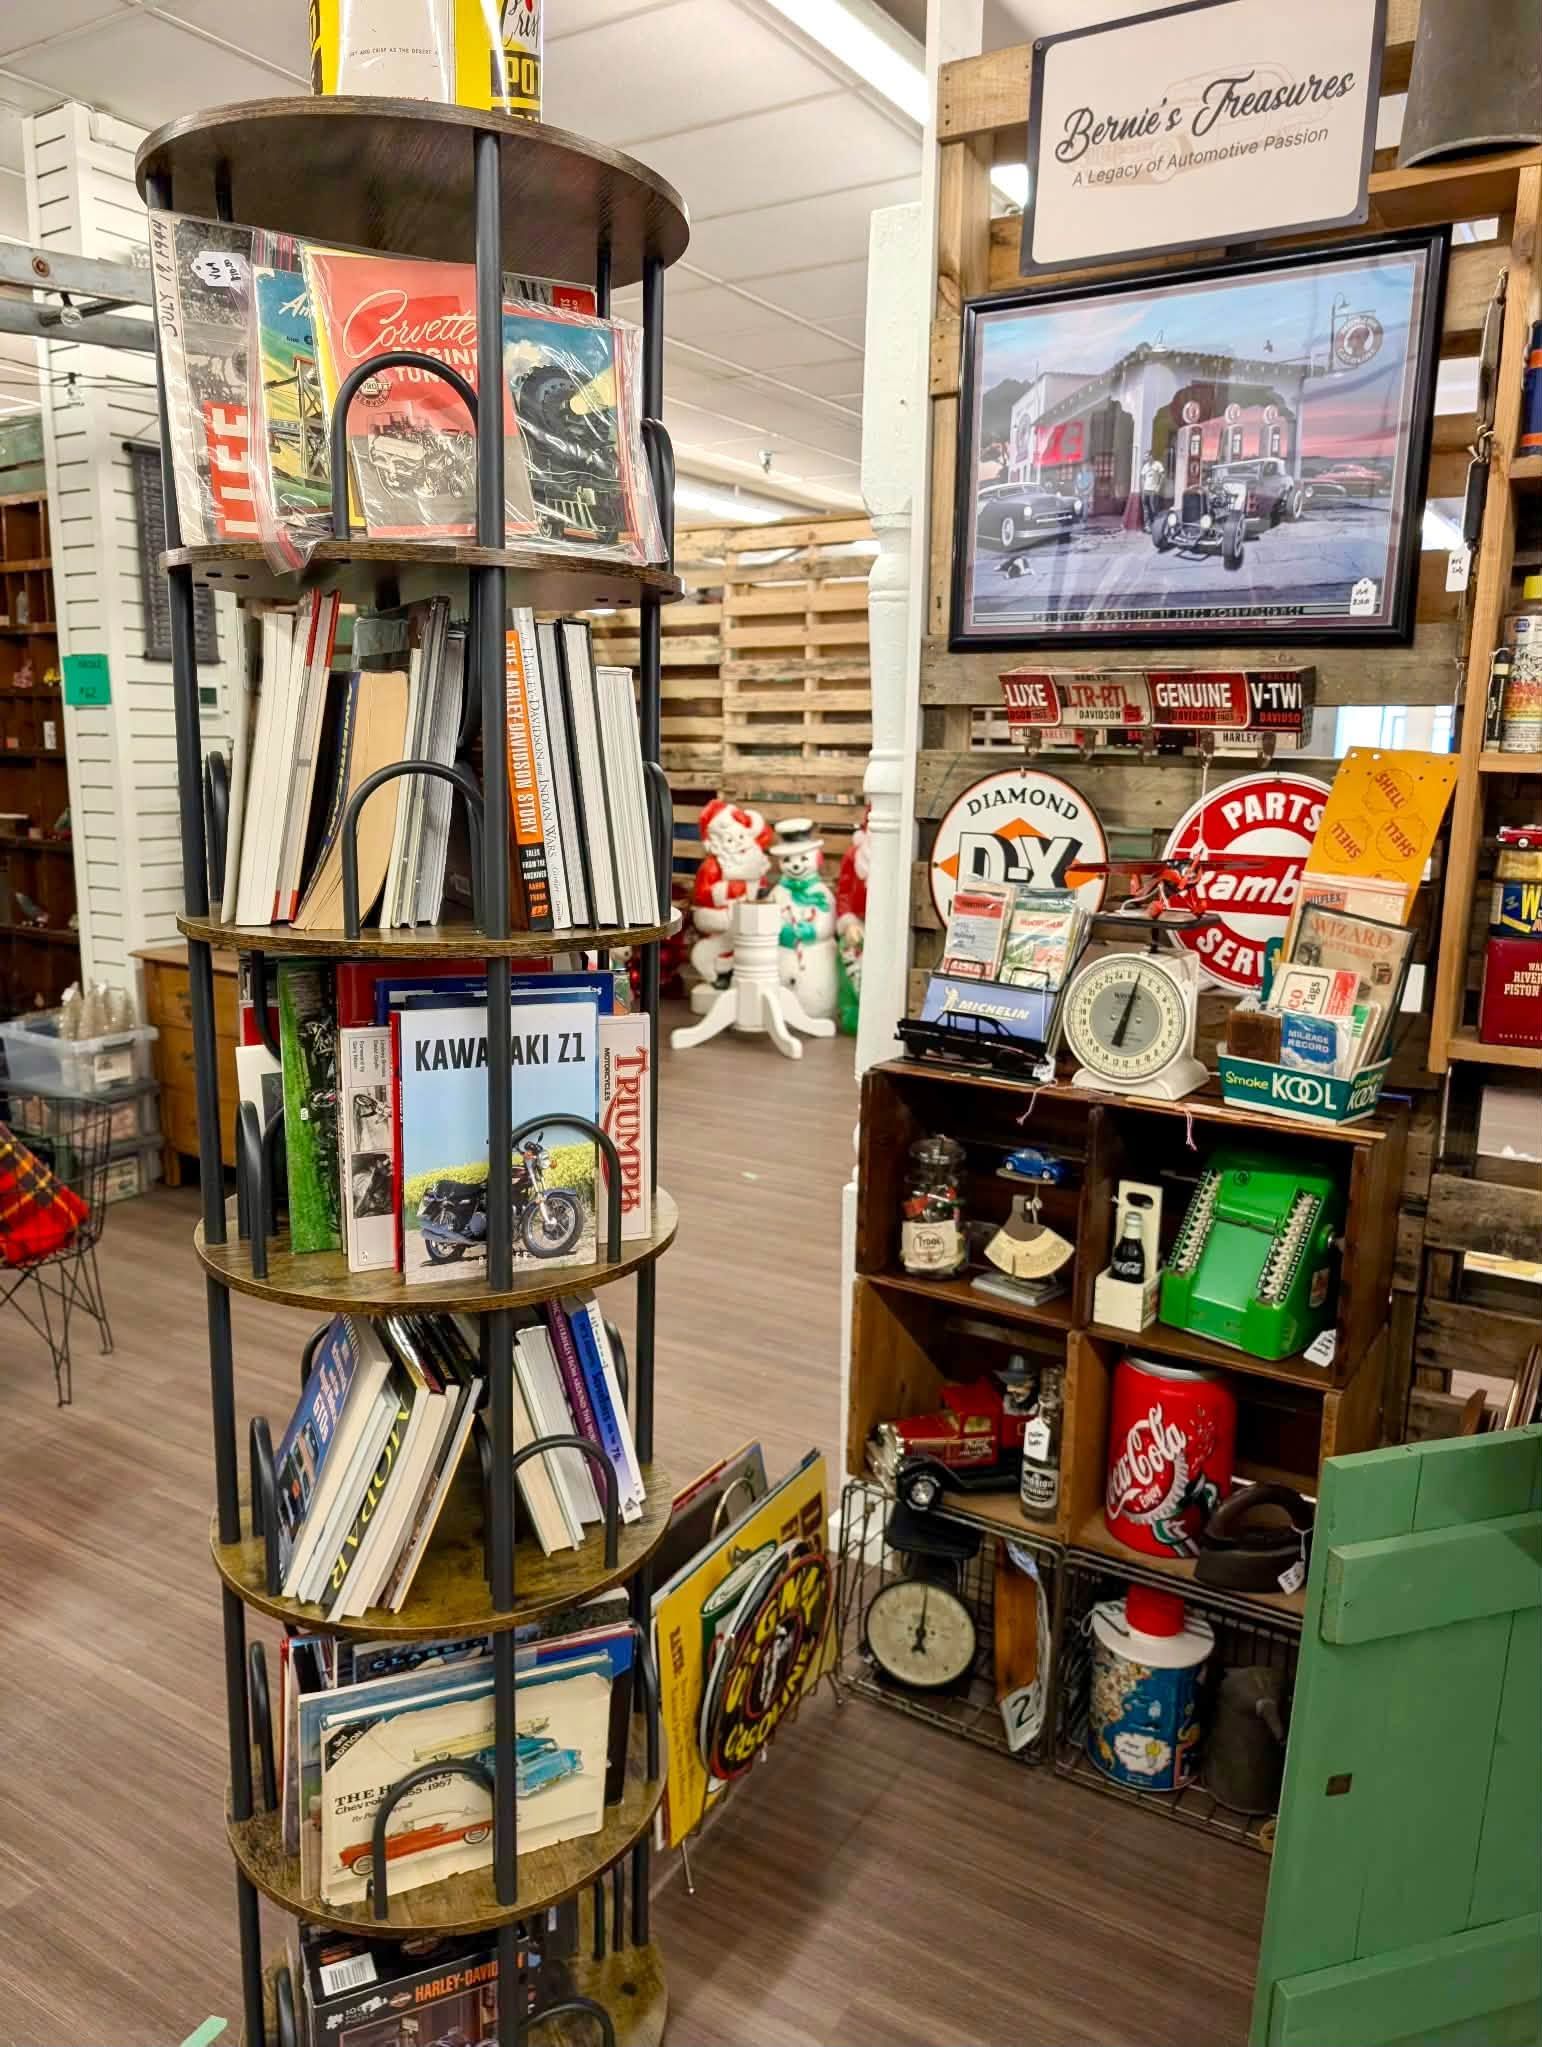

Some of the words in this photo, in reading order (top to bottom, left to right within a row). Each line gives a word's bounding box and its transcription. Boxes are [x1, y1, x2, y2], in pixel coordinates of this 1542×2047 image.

[1055, 99, 1182, 163] Bernie's
[1192, 70, 1355, 136] Treasures
[1072, 170, 1083, 186] A
[1087, 160, 1142, 187] Legacy
[1147, 154, 1163, 173] of
[1166, 140, 1258, 168] Automotive
[1263, 127, 1329, 152] Passion
[159, 292, 178, 337] JULY
[343, 289, 477, 359] Corvette
[522, 646, 545, 760] HARLEY-DAVIDSON
[1157, 683, 1233, 708] GENUINE
[1079, 710, 1121, 720] DAVIDSON
[506, 671, 526, 789] HARLEY-DAVIDSON
[518, 791, 538, 834] STORY
[538, 779, 554, 823] INDIAN
[967, 788, 1079, 820] DIAMOND
[1375, 772, 1405, 809] SHELL
[1221, 792, 1325, 832] PARTS
[544, 824, 558, 857] WARS
[1330, 822, 1361, 859] SHELL
[1385, 820, 1417, 858] SHELL
[1312, 915, 1393, 950] WIZARD
[1302, 981, 1320, 1006] Tags
[1504, 983, 1540, 997] PISTON
[958, 1000, 1030, 1020] MICHELIN
[415, 1034, 549, 1072] KAWAAKI
[557, 1032, 586, 1063] Z1
[1288, 1030, 1329, 1043] MILEAGE
[1288, 1039, 1329, 1053] RECORD
[603, 1047, 611, 1101] MOTORCYCLES
[1225, 1071, 1269, 1090] Smoke
[1272, 1072, 1337, 1110] KOOL
[614, 1046, 650, 1215] TRIUMPH
[1012, 1694, 1035, 1728] 2
[332, 1730, 363, 1760] EDITION
[335, 1788, 375, 1807] THE
[335, 1797, 385, 1815] Chevrol
[415, 1960, 498, 2002] HARLEY-DAVID
